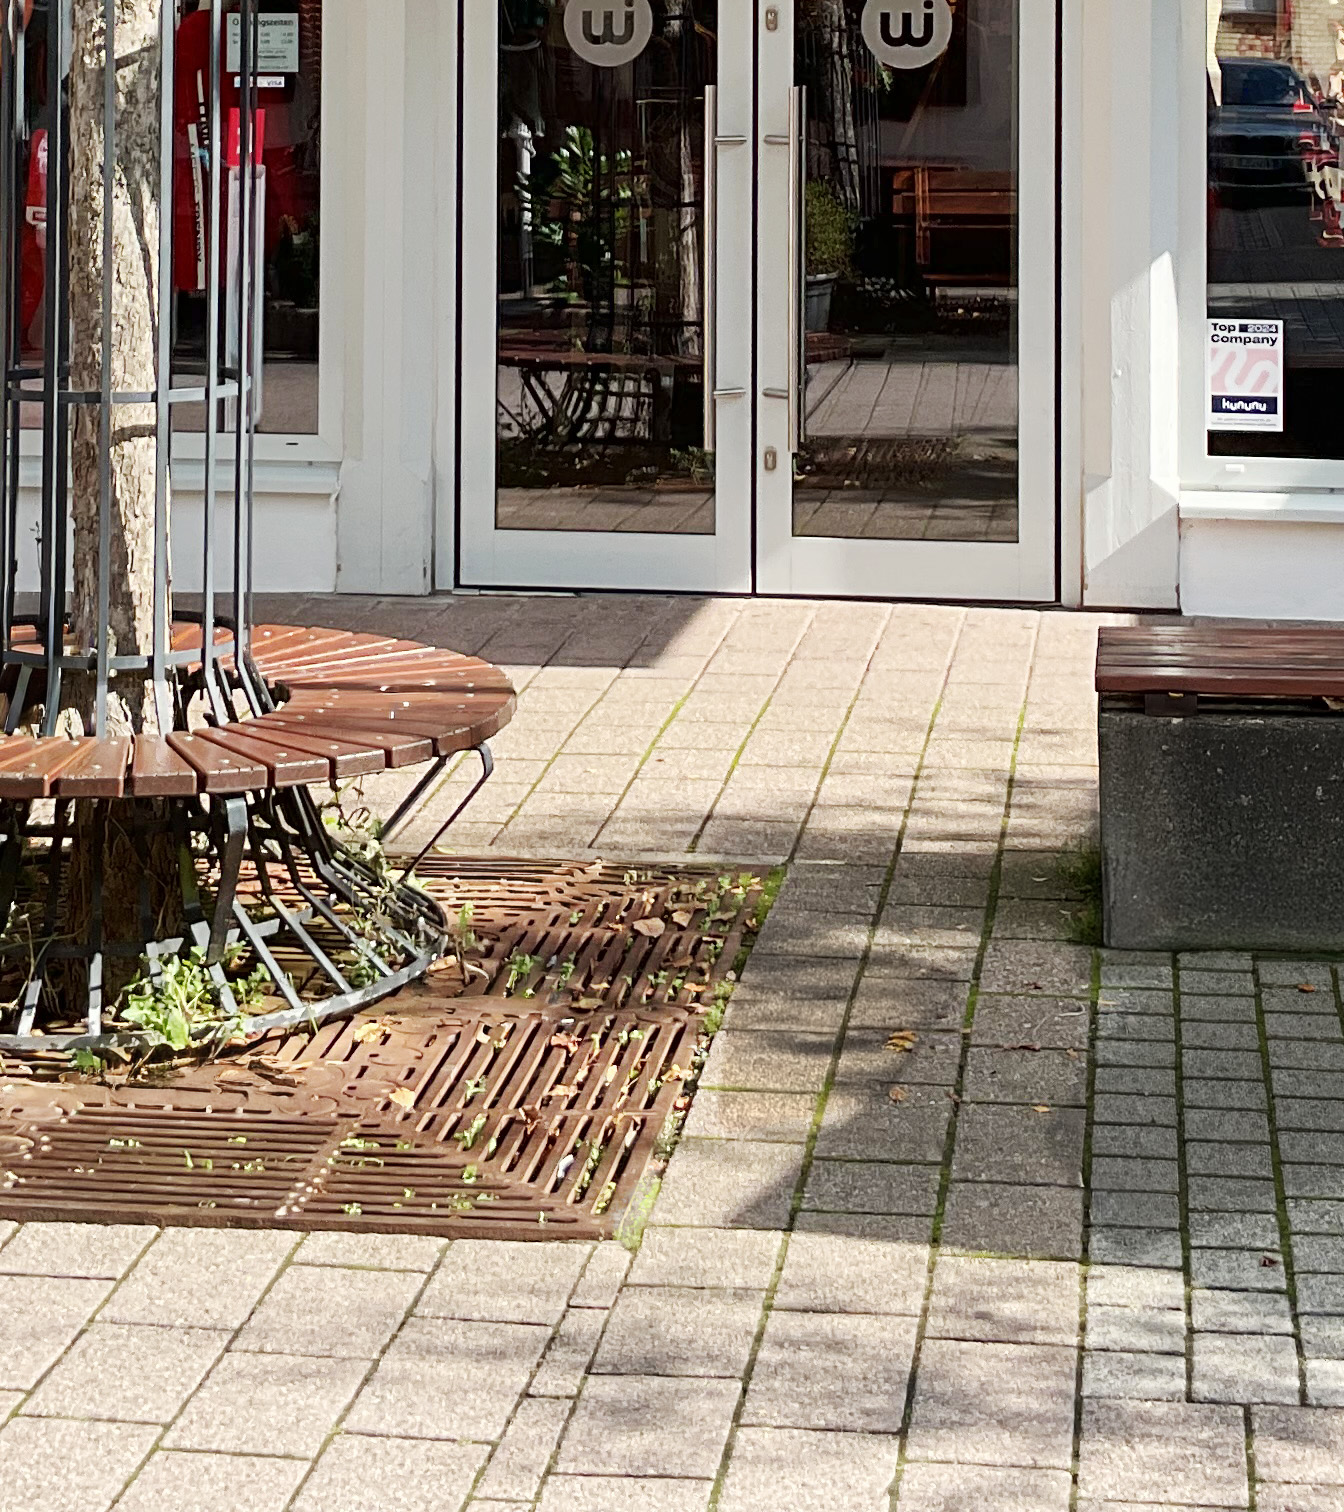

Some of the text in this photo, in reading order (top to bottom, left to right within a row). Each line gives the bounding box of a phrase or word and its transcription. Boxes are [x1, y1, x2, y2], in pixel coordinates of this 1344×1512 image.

[1211, 322, 1277, 334] Top 2024
[1211, 334, 1278, 347] Company
[1222, 397, 1267, 412] kununu
